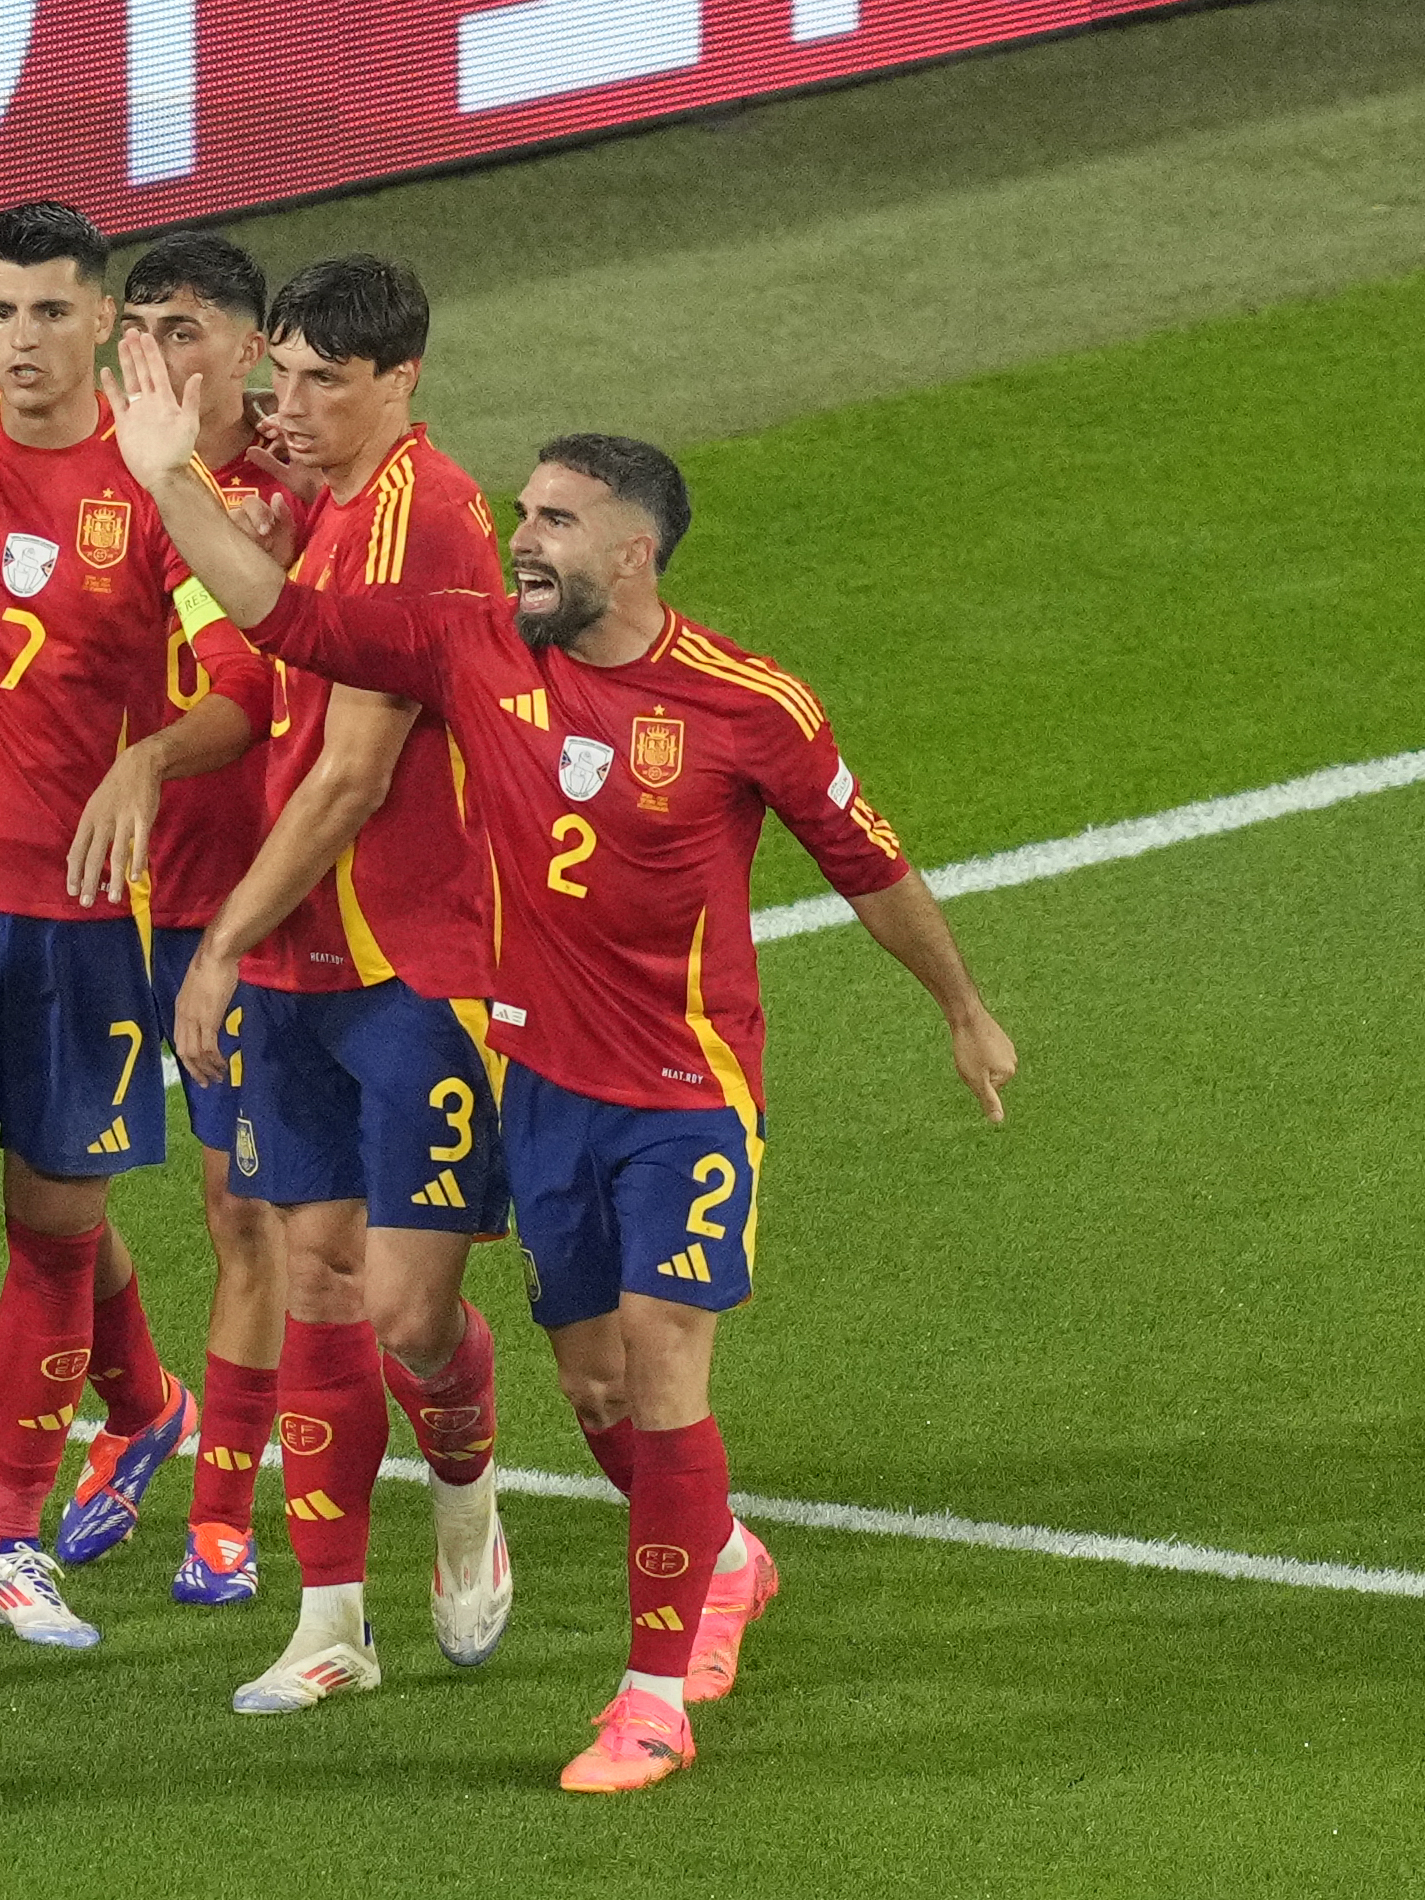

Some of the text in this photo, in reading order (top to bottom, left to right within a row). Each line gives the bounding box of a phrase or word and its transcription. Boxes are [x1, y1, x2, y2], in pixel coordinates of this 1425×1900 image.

[1, 607, 46, 690] 7
[547, 813, 598, 899] 2
[109, 1020, 144, 1106] 7
[428, 1076, 474, 1162] 3
[685, 1152, 736, 1240] 2
